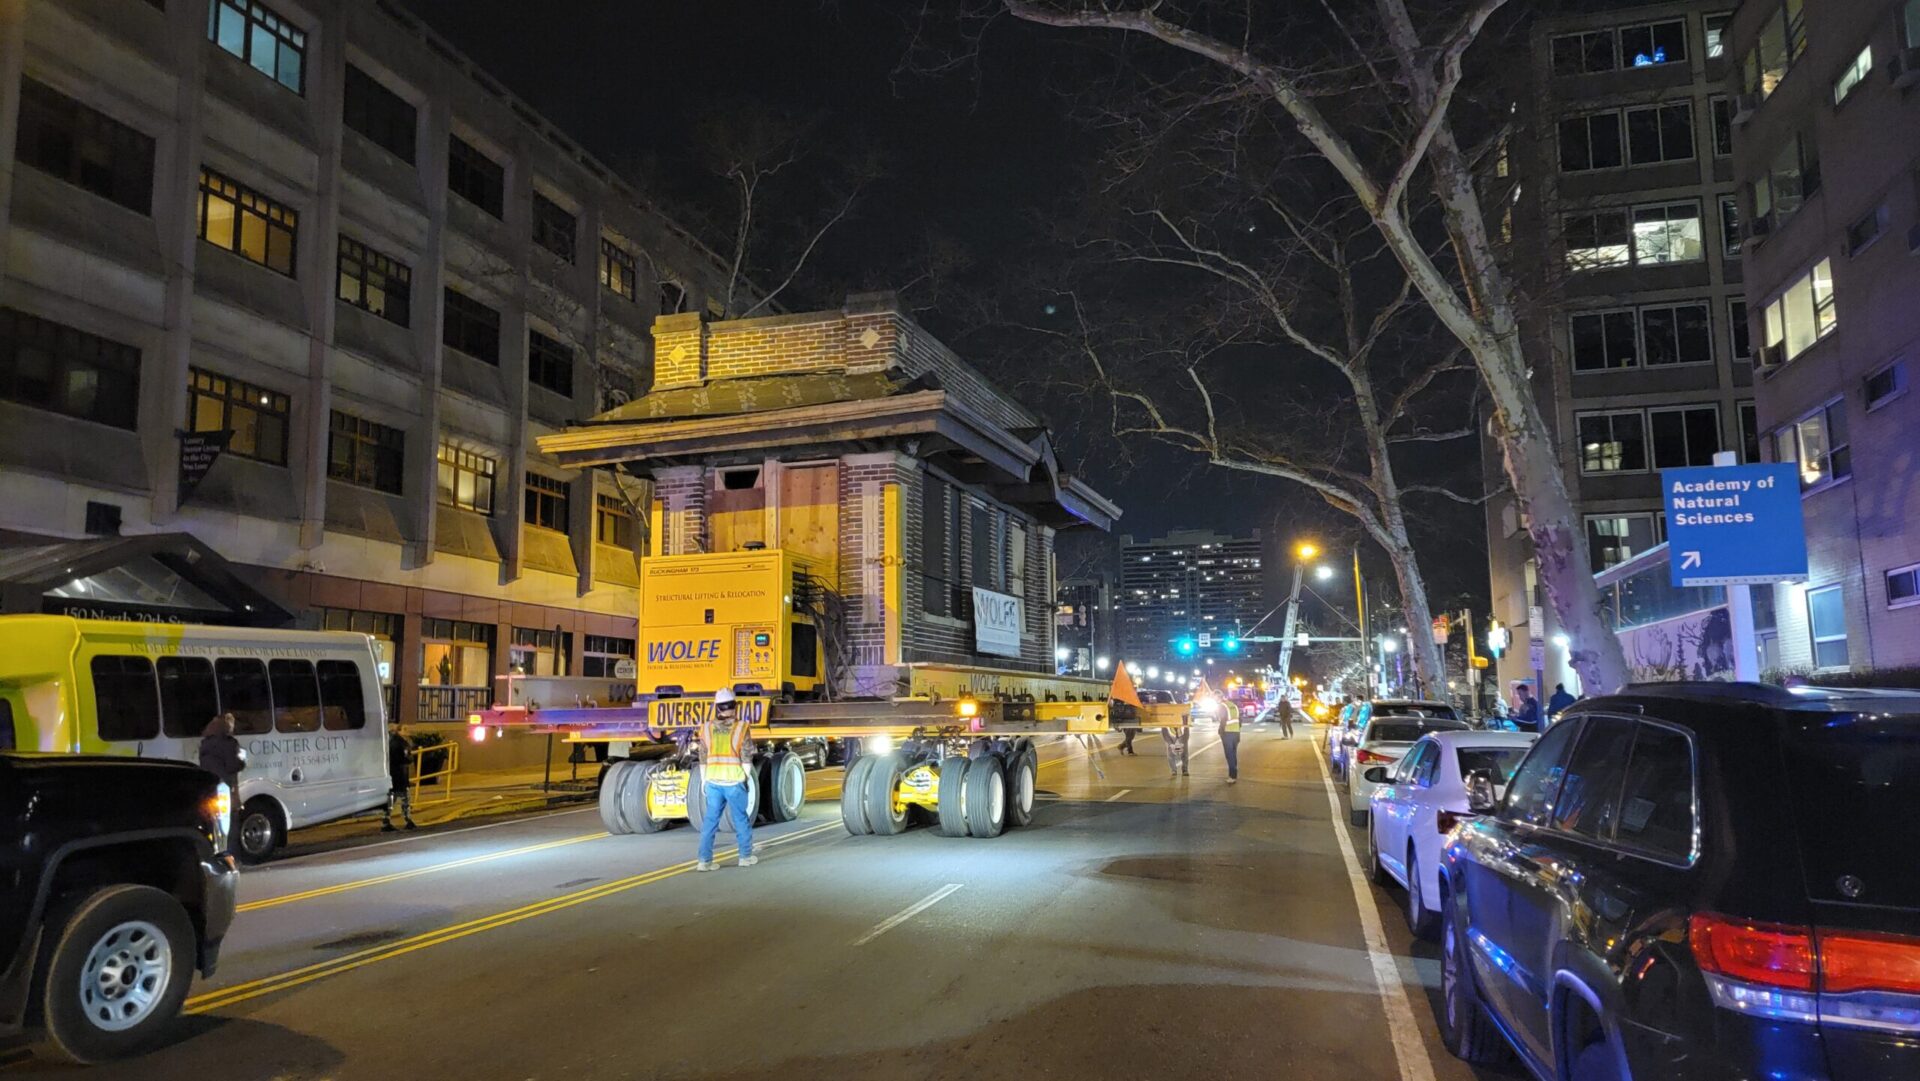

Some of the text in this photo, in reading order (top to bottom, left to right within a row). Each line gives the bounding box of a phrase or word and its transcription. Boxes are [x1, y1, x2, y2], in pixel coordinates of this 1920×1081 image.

[1672, 476, 1774, 493] Academy of
[1673, 494, 1740, 509] Natural
[1675, 512, 1754, 526] Sciences
[656, 593, 693, 601] STRUCTURAL
[694, 592, 719, 600] LIFTING
[727, 590, 766, 598] RELOCATION
[63, 607, 88, 620] 150
[975, 591, 1016, 627] WOLFE
[648, 639, 722, 662] WOLFE
[657, 700, 762, 726] OVERSIZ OAD
[249, 736, 348, 756] CENTER CITY
